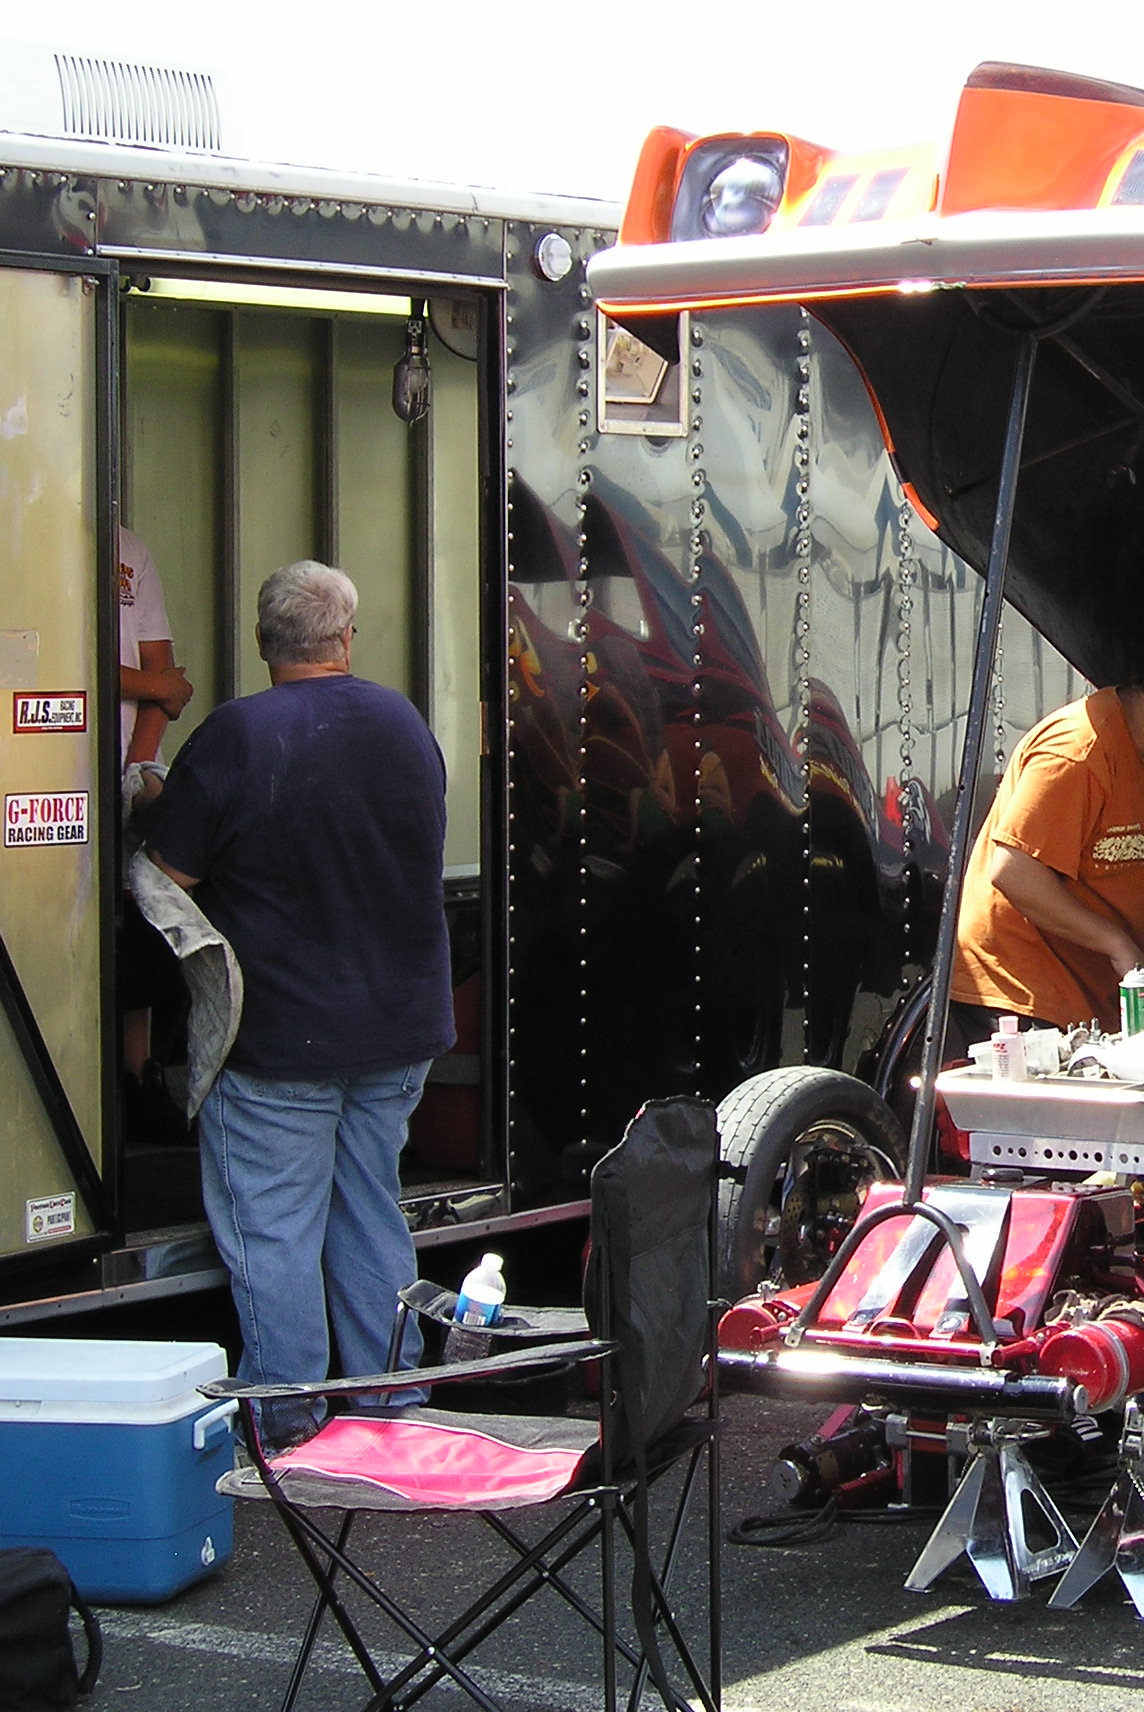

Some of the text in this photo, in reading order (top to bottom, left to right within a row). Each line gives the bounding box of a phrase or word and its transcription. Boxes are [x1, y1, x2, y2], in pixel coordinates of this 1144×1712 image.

[20, 700, 52, 724] R.J.S.
[8, 797, 84, 824] G-FORCE
[8, 825, 84, 842] RACING GEAR
